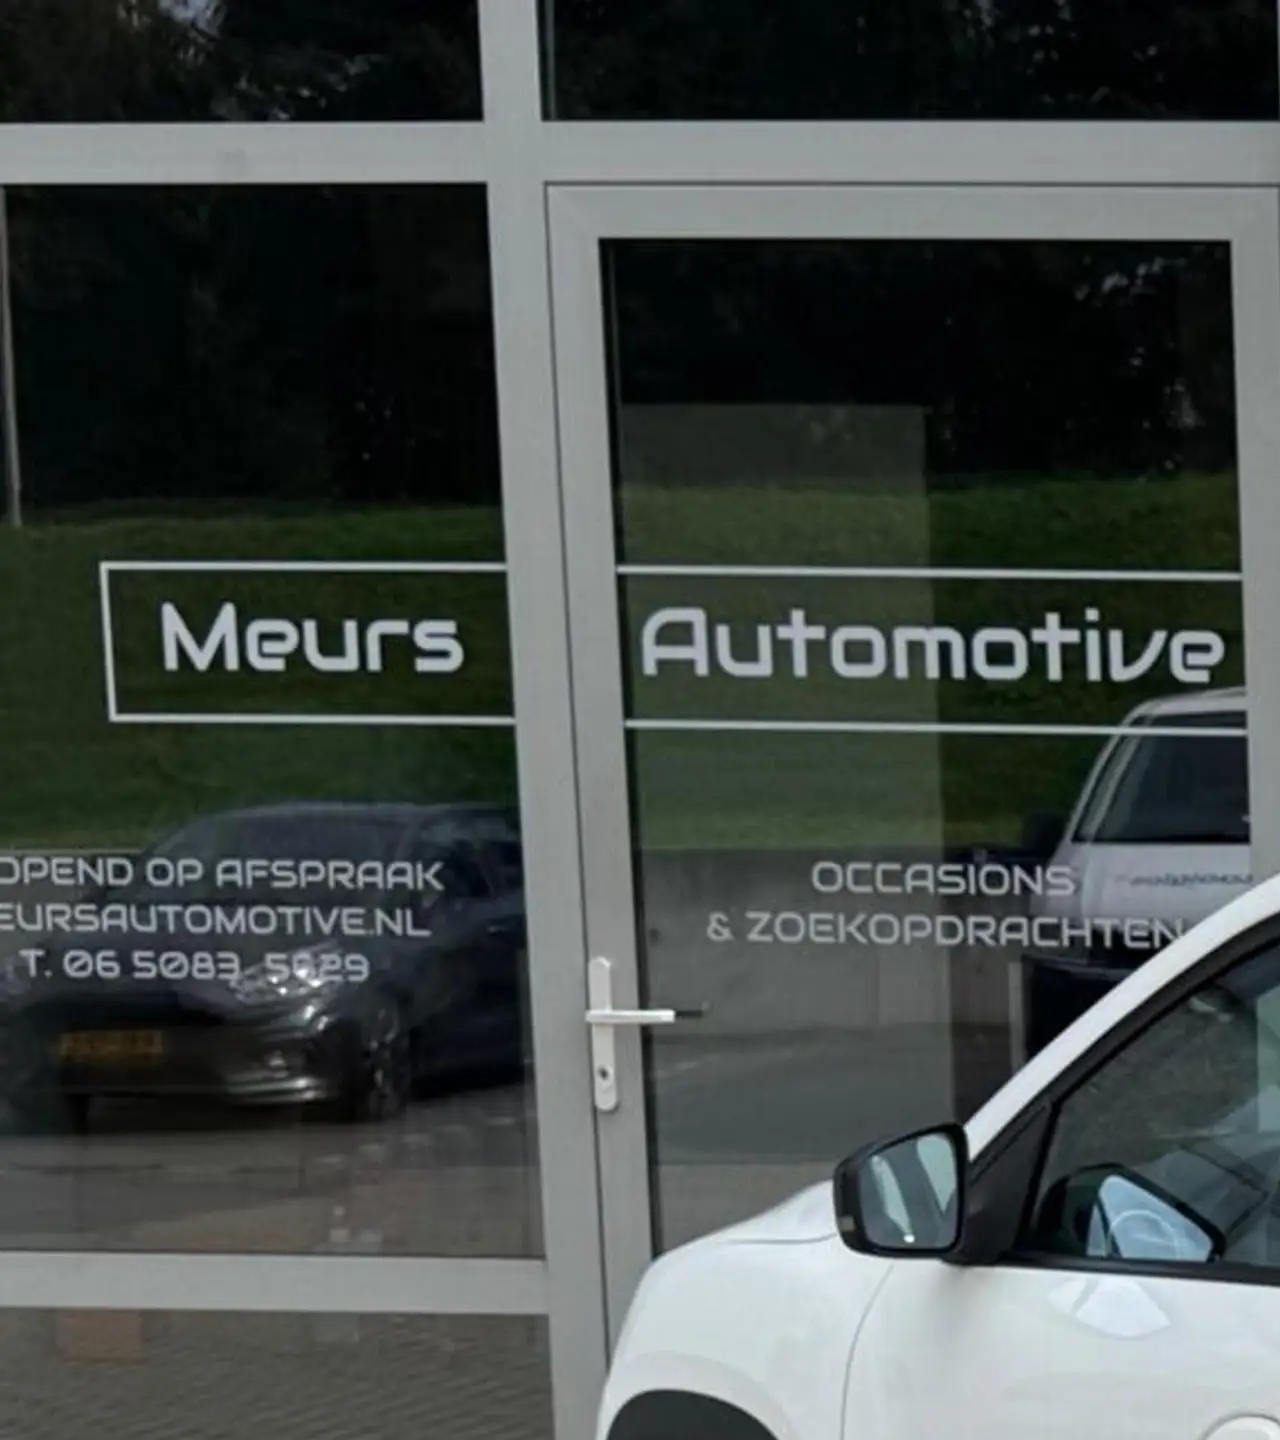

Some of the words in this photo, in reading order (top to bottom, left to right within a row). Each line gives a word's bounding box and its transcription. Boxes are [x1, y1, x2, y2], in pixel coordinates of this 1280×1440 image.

[160, 602, 465, 673] Meurs
[640, 606, 1226, 684] Automotive
[146, 857, 203, 887] OP
[216, 860, 446, 892] AFSPRAAK
[811, 861, 1078, 896] OCCASIONS
[706, 912, 735, 942] &
[746, 912, 1184, 949] ZOEKOPDRACHTEN
[19, 949, 52, 979] T.
[63, 950, 122, 980] 06
[133, 951, 240, 981] 5083
